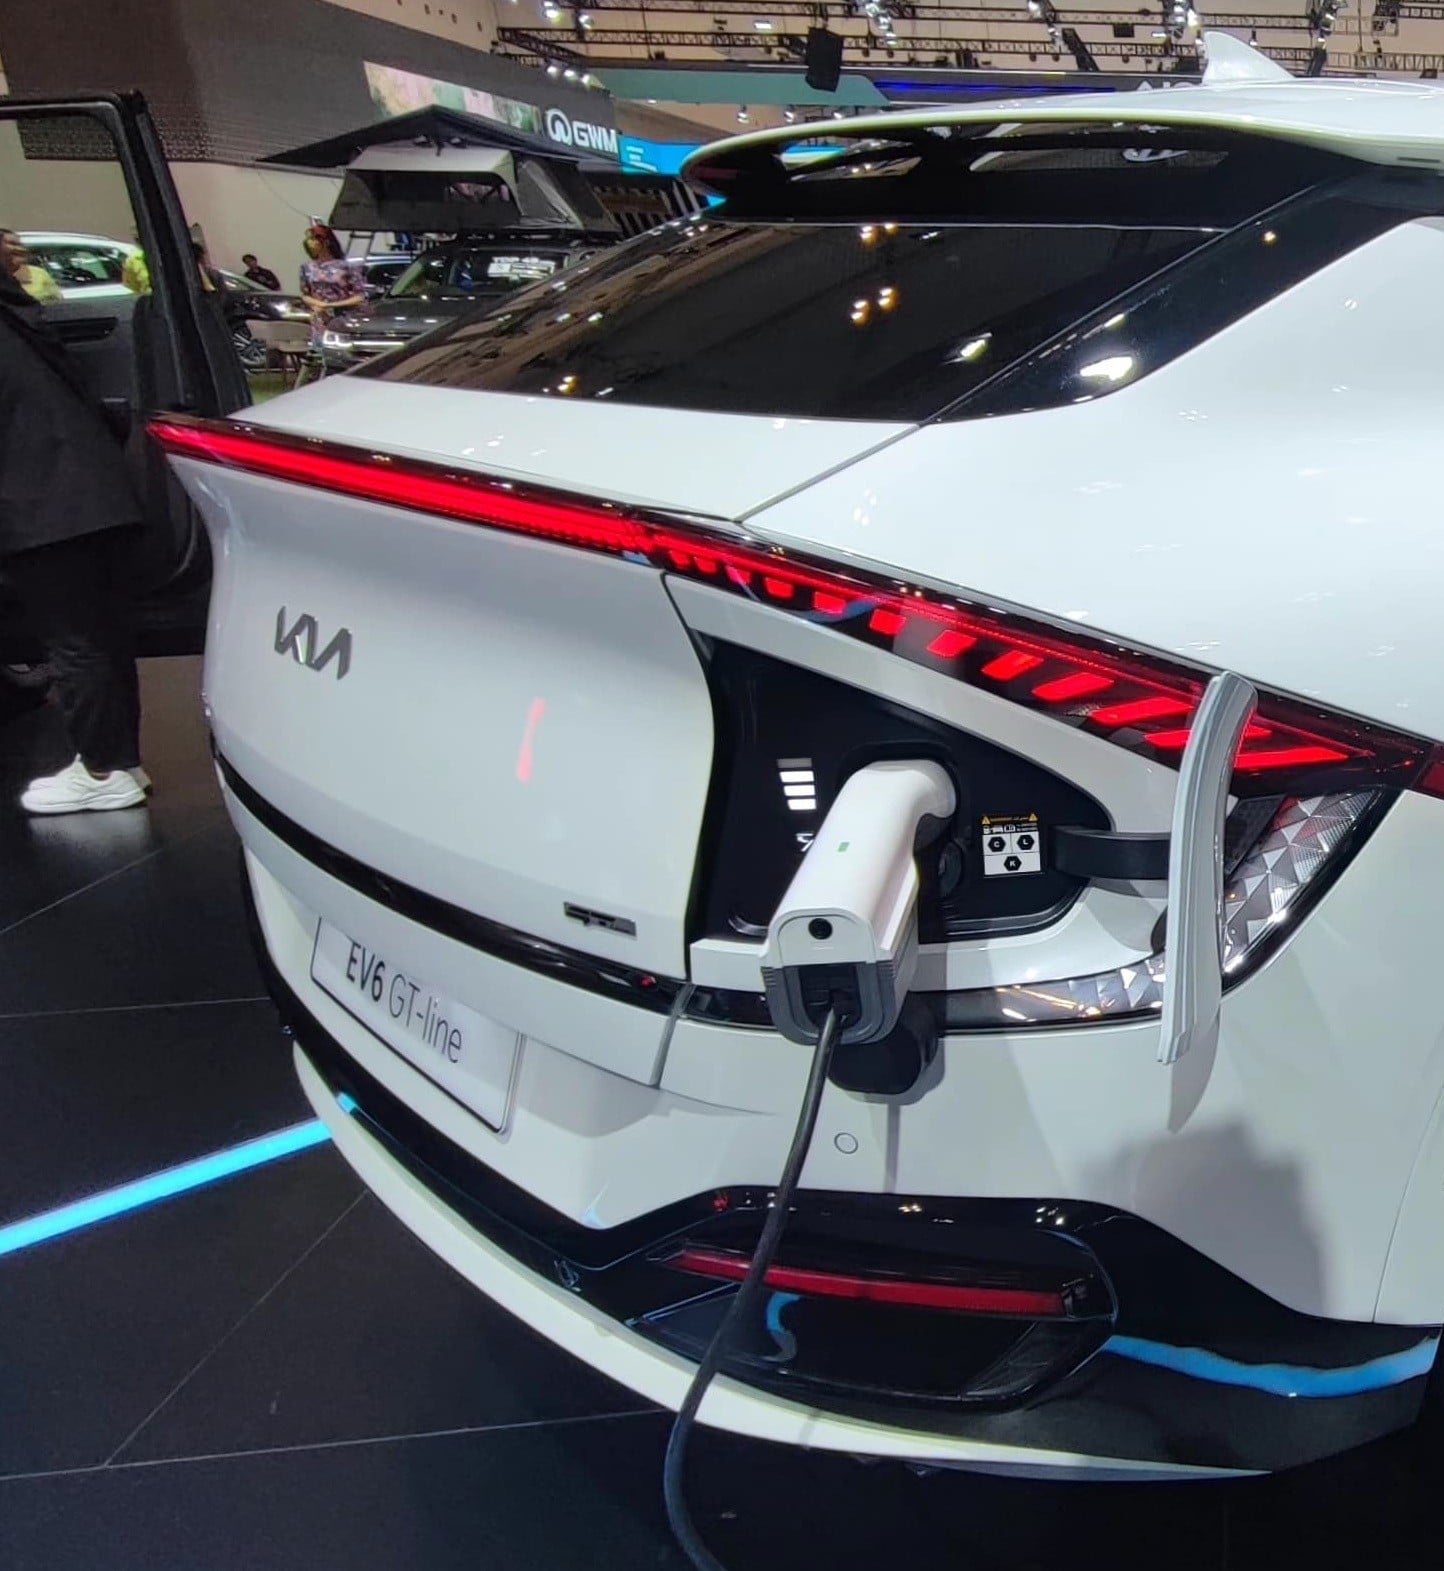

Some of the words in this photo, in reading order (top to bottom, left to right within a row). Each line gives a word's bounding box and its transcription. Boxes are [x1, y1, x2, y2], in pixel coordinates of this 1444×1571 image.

[572, 120, 619, 154] GWM
[274, 605, 352, 681] KIA
[346, 940, 386, 1002] EV6
[389, 974, 462, 1064] GT-line
